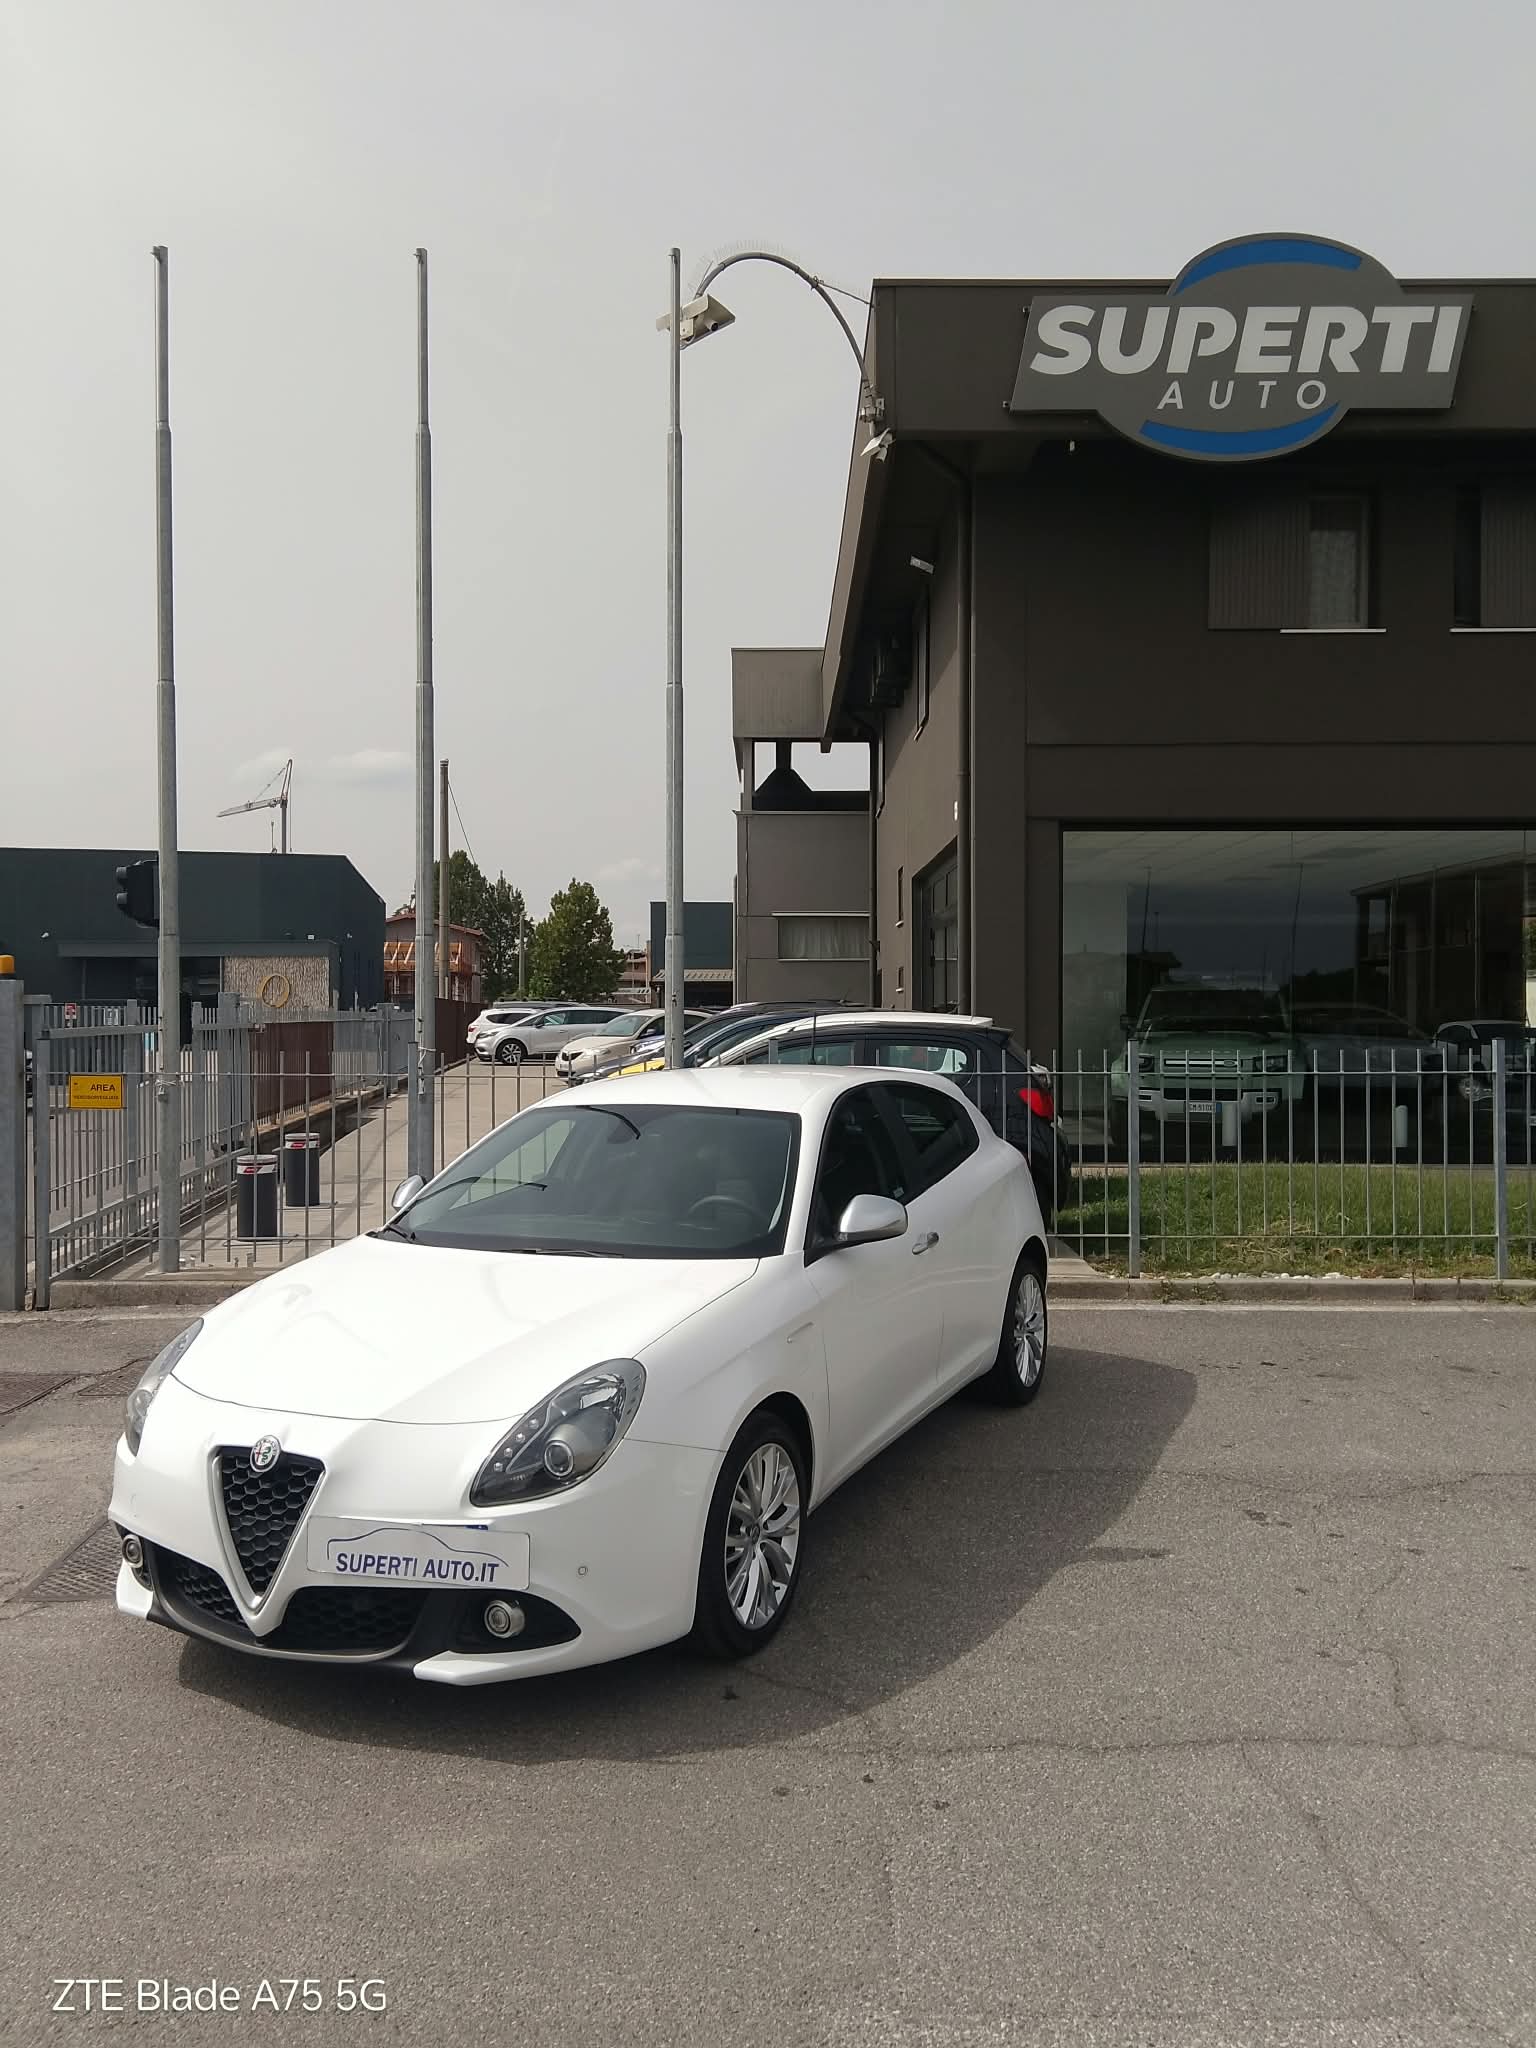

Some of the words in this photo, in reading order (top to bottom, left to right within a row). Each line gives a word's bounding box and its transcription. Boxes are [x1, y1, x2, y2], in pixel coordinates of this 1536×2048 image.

[1029, 304, 1463, 376] SUPERTI
[1156, 379, 1327, 411] AUTO
[90, 1083, 116, 1092] AREA
[335, 1552, 418, 1577] SUPERTI
[422, 1558, 499, 1583] AUTO.IT
